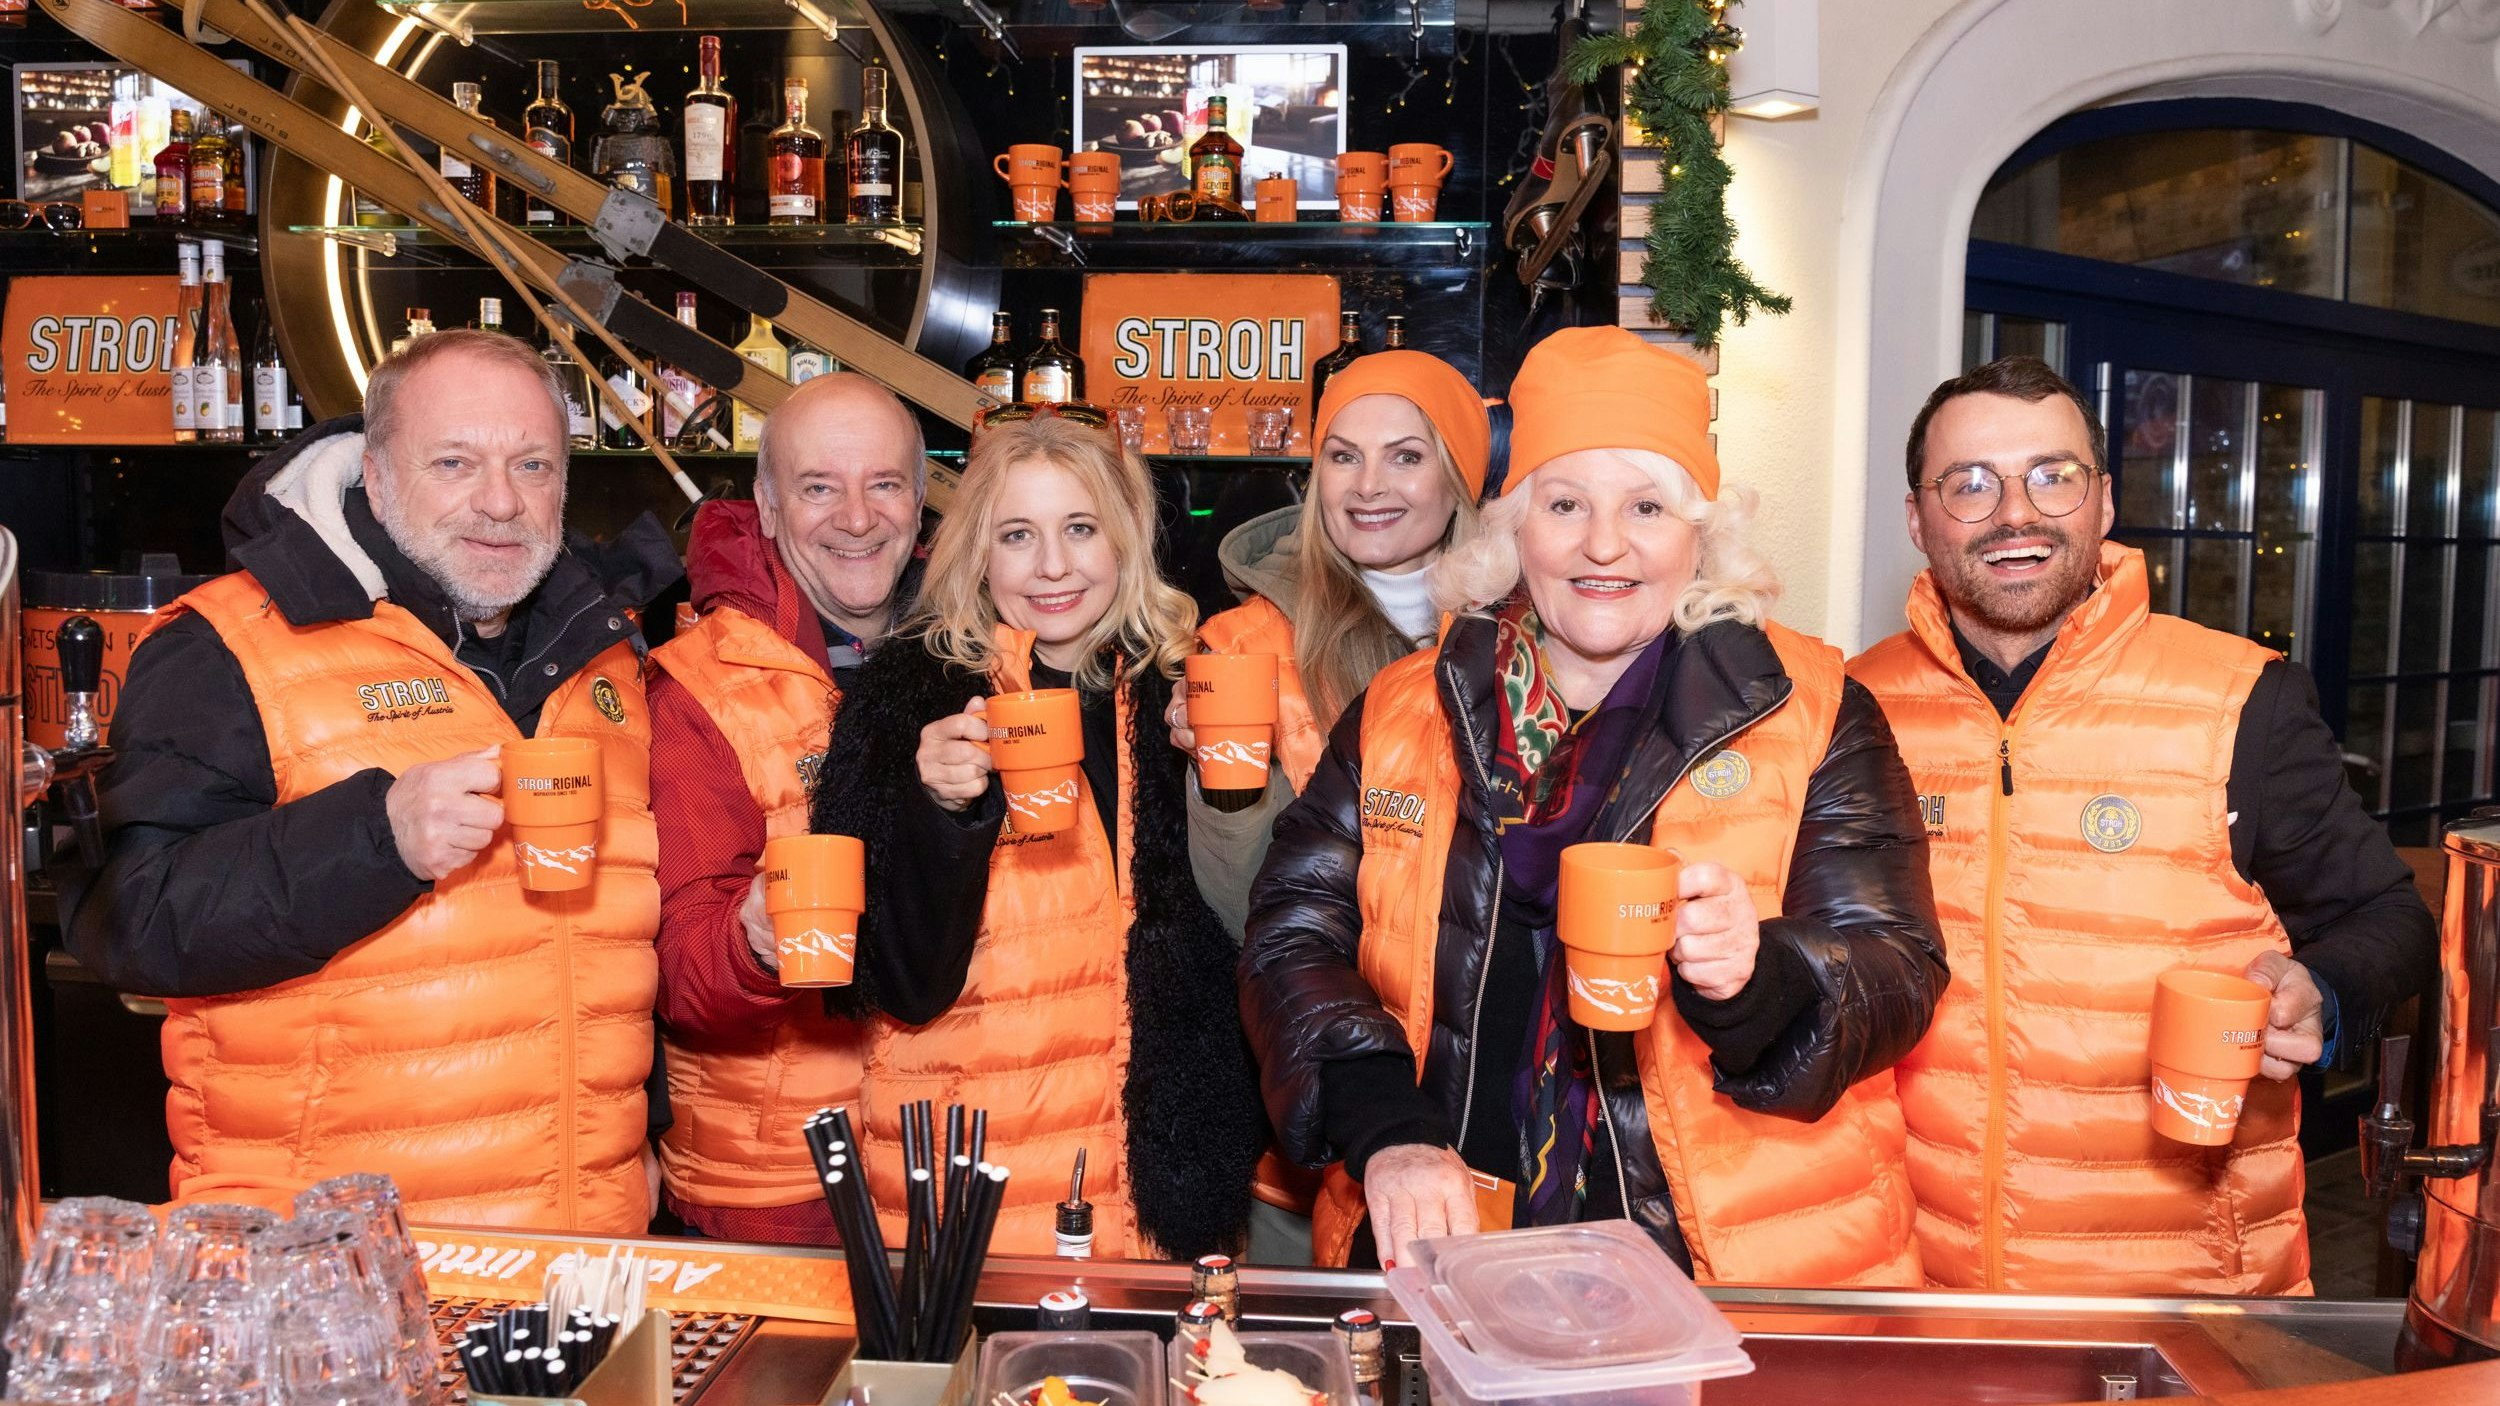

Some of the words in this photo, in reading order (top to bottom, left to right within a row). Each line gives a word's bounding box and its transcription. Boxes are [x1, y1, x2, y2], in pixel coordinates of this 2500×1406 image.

[804, 198, 814, 209] 8
[1113, 317, 1306, 382] STROH
[22, 379, 56, 397] The
[57, 379, 103, 404] Spirit
[103, 380, 130, 402] of
[124, 379, 172, 397] Austr
[1112, 385, 1147, 405] The
[1151, 386, 1204, 412] Spirit
[1208, 387, 1231, 411] of
[1228, 387, 1301, 407] Austria
[357, 677, 452, 711] STROH
[420, 705, 455, 717] Austria
[517, 775, 593, 791] STROHRIGINAL
[2100, 818, 2123, 828] STROH
